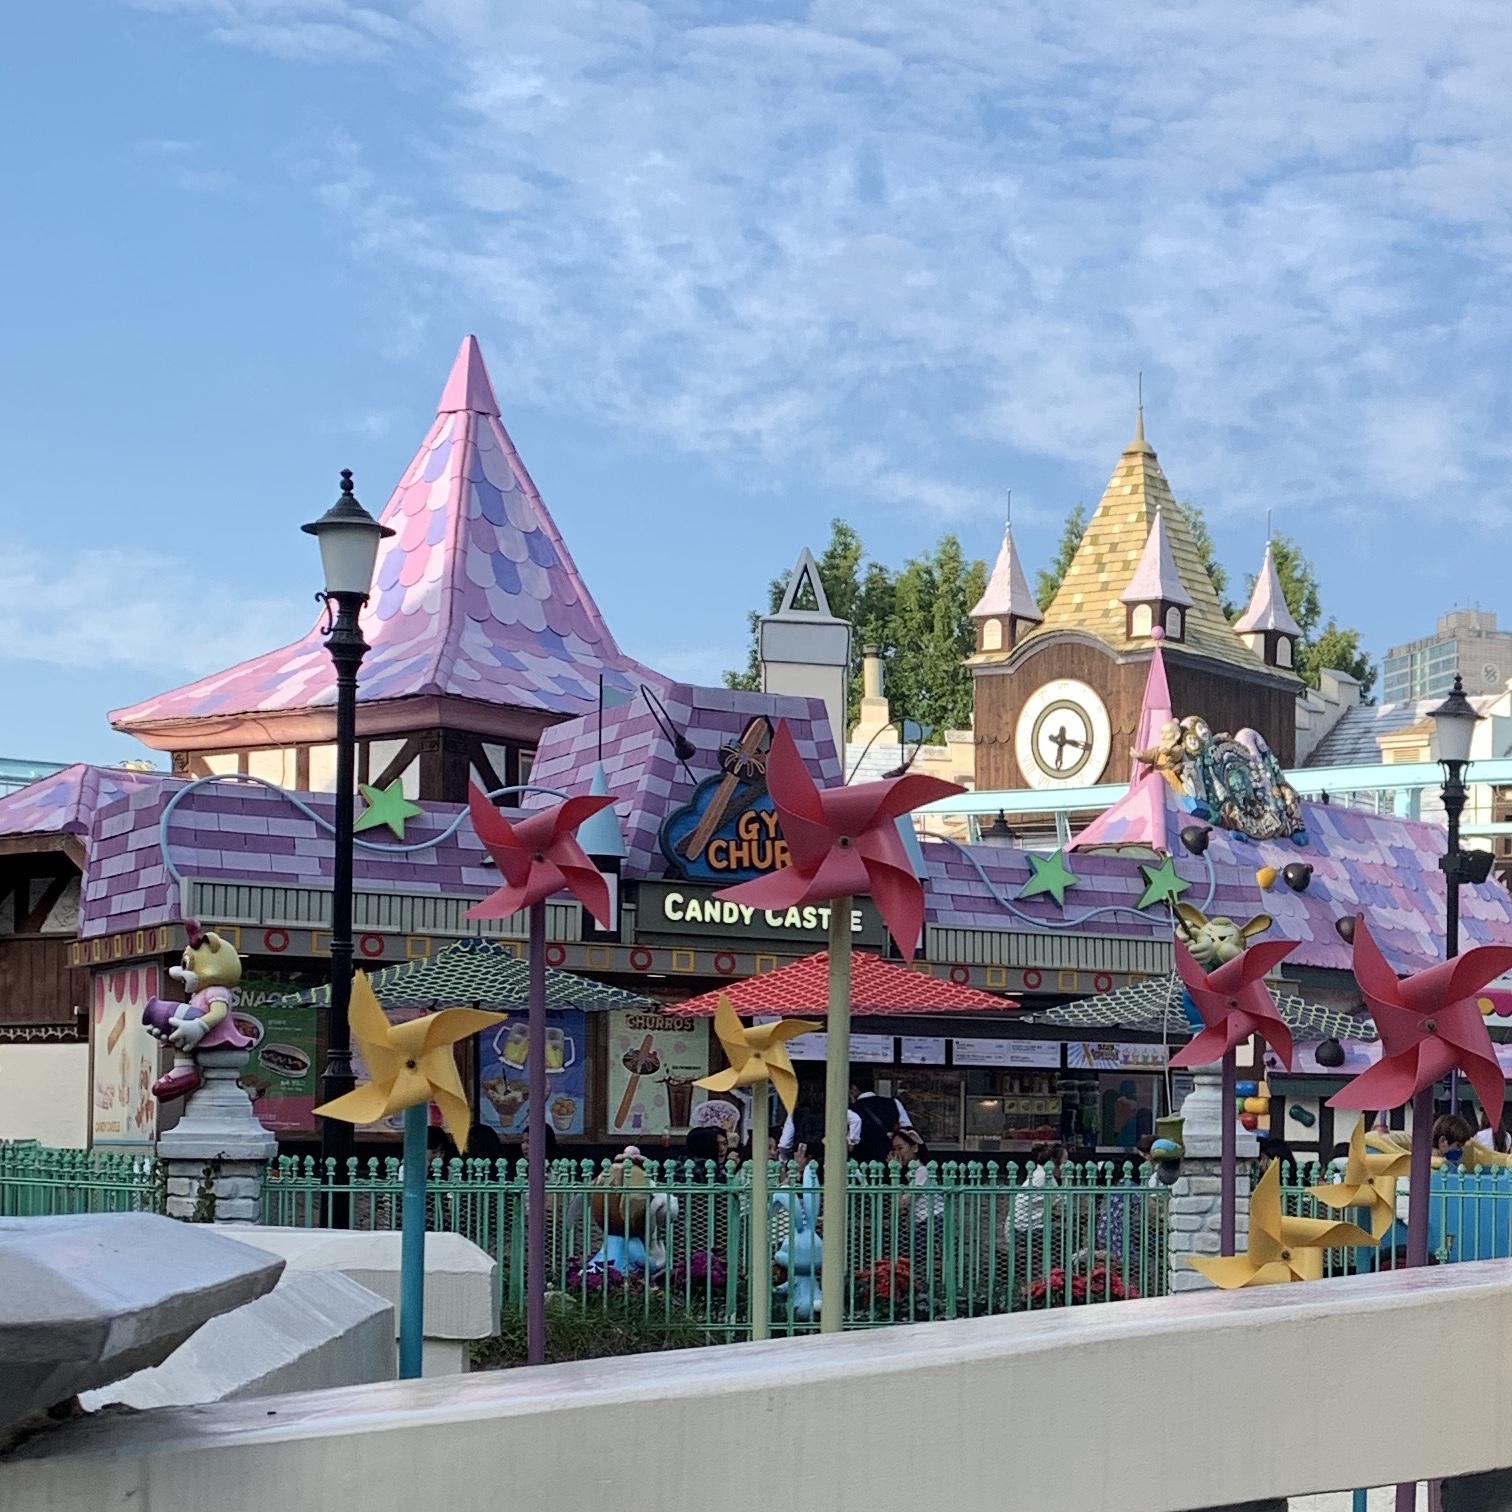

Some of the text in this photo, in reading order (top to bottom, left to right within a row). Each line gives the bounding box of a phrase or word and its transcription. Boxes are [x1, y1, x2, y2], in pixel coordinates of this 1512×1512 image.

[738, 810, 779, 841] GY
[707, 839, 792, 870] CHUR
[664, 892, 863, 932] CANDY CASTE
[626, 1014, 693, 1031] CHURROS
